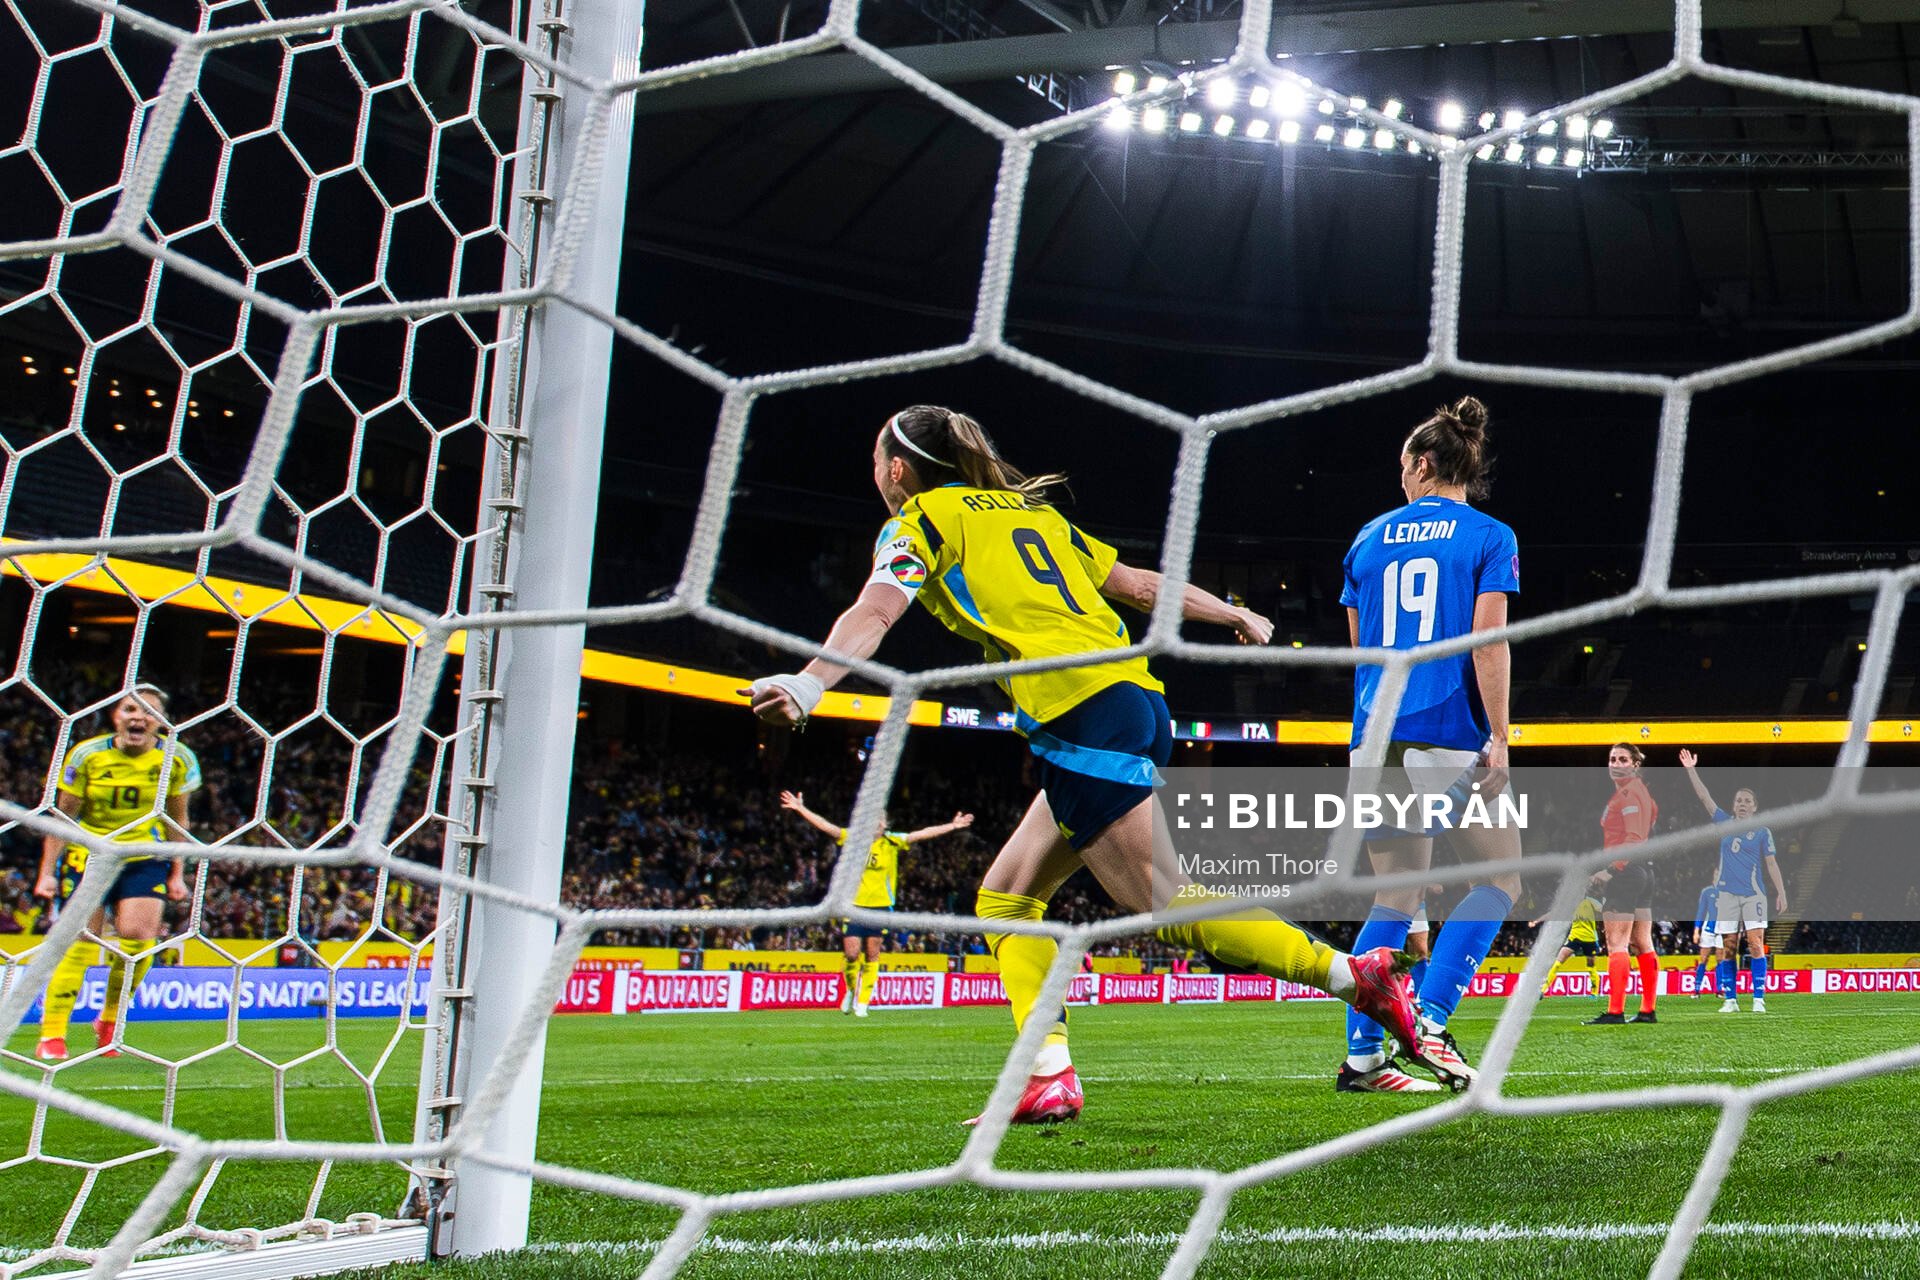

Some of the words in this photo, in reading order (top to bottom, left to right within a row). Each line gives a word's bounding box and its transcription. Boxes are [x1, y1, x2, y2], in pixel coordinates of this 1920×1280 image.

[1383, 520, 1457, 544] LENZINI
[1012, 527, 1088, 616] 9
[1382, 557, 1439, 647] 19
[946, 706, 981, 726] SWE
[1242, 722, 1270, 739] ITA
[109, 786, 140, 809] 19
[1731, 837, 1743, 854] 6
[1756, 901, 1764, 918] 6
[628, 976, 730, 1006] BAUHAUS
[751, 976, 839, 1004] BAUHAUS
[870, 979, 934, 1002] AUHAUS
[1104, 978, 1159, 1000] BAUHAUS
[1171, 977, 1219, 999] BAUHAUS
[1228, 978, 1272, 998] BAUHAUS
[1827, 973, 1920, 991] BAUHAU
